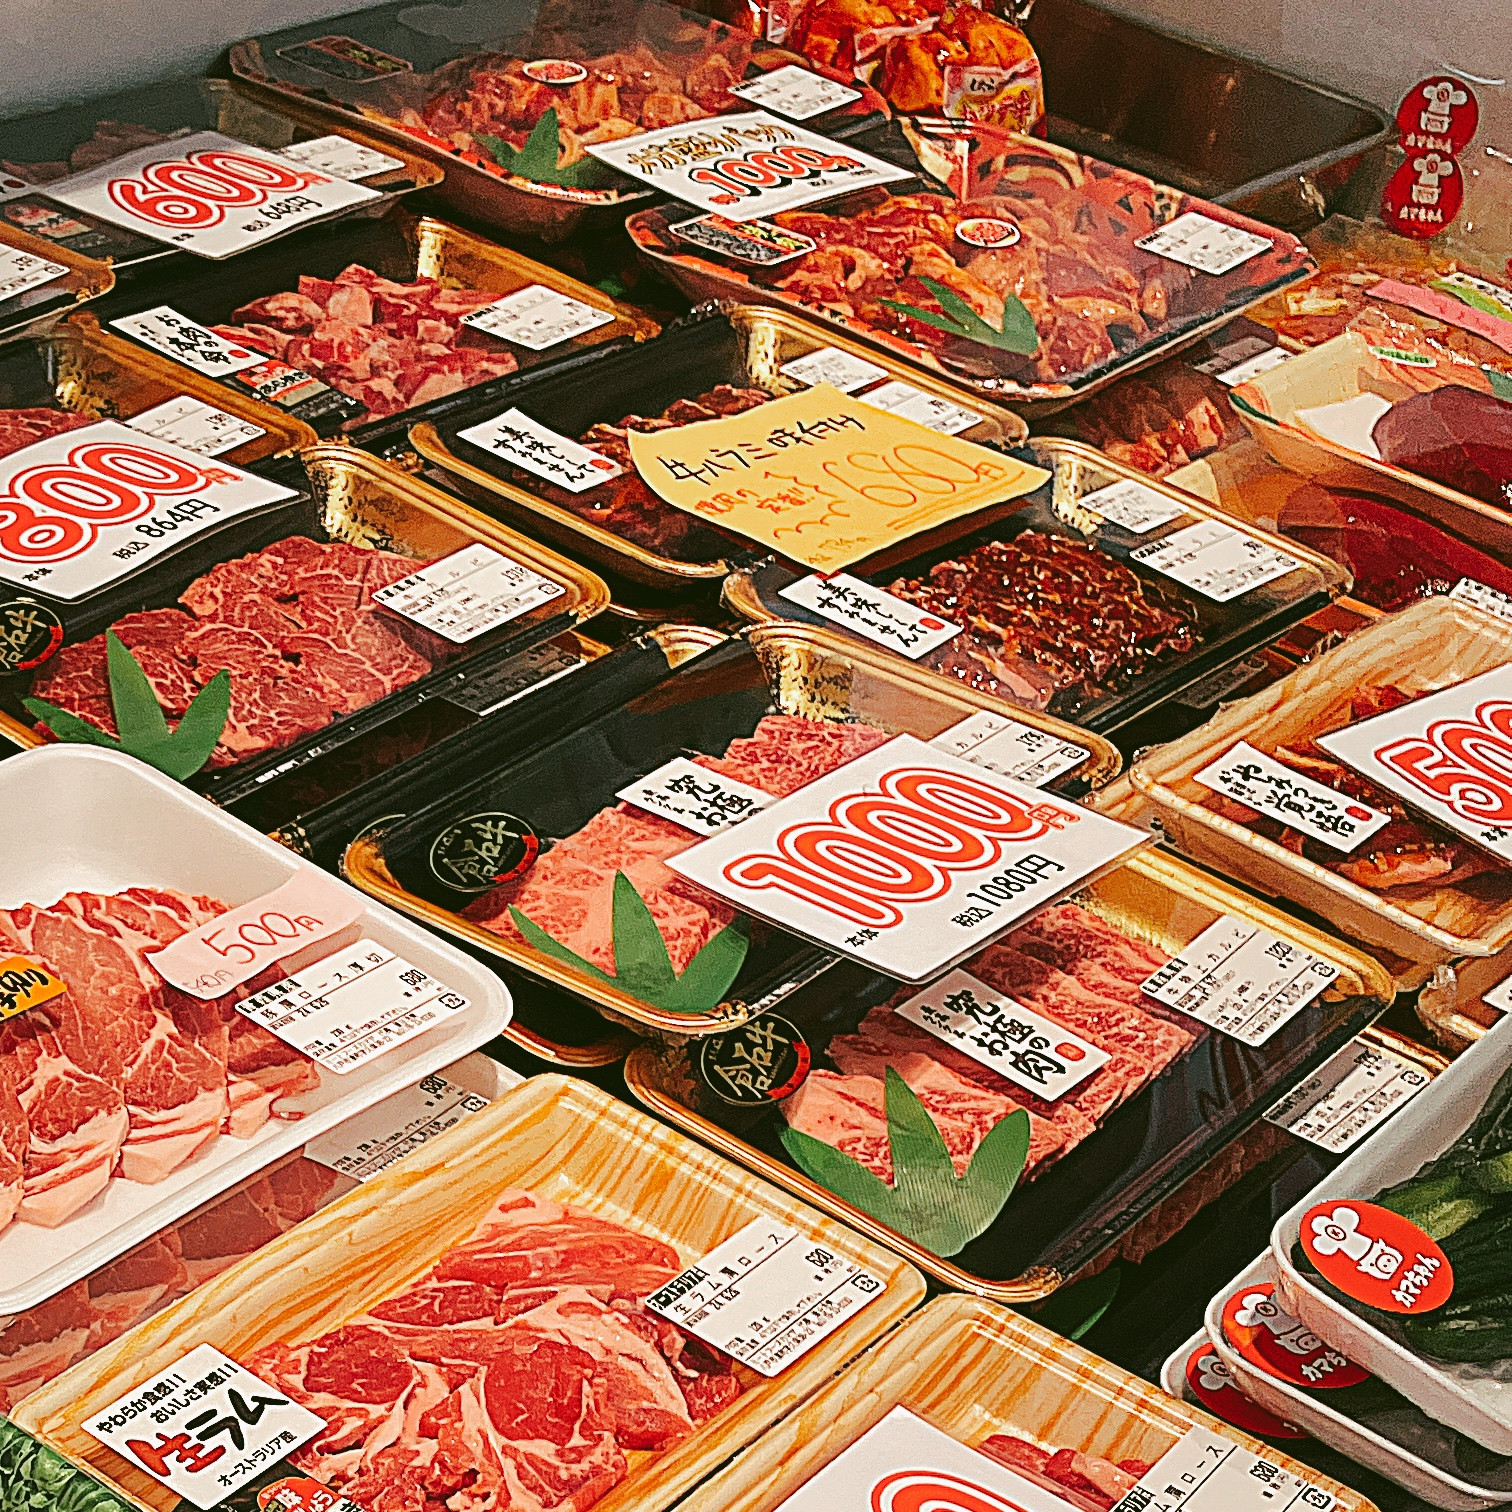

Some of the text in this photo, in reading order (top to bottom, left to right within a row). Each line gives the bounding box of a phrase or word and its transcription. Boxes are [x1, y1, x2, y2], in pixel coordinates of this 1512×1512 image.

[108, 150, 330, 229] 600円
[112, 499, 220, 559] 税込 864円
[723, 765, 1080, 930] 1000円
[951, 853, 1066, 927] 税込 1080円
[201, 912, 324, 964] 500円
[845, 929, 879, 947] 本体
[1391, 1253, 1440, 1308] カマちゃん
[125, 1390, 288, 1478] 生ラム
[218, 1430, 297, 1488] オーストラリア産
